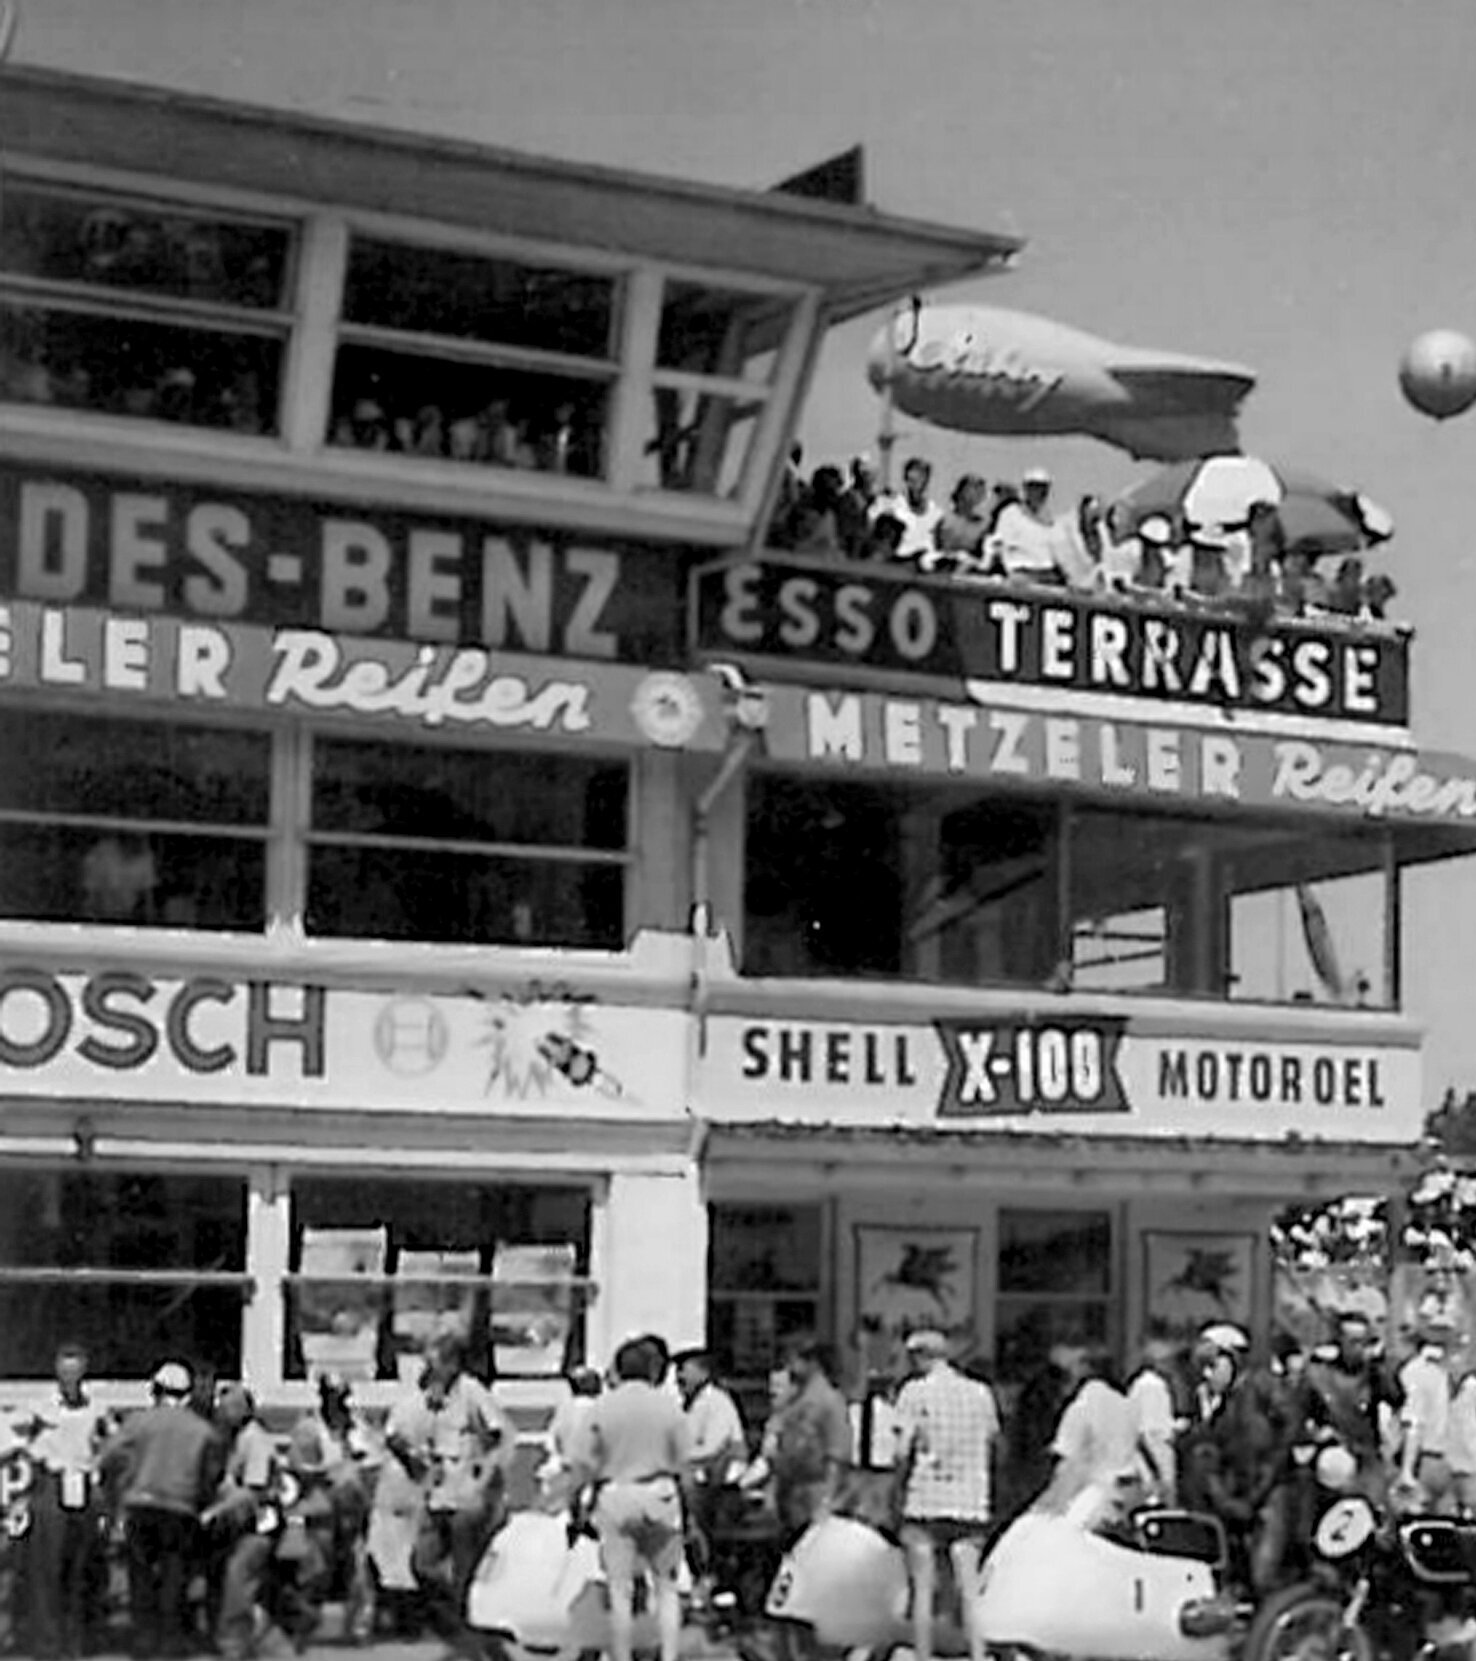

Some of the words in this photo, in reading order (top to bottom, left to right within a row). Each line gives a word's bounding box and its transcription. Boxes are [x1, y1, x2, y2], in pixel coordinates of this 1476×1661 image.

[0, 606, 233, 698] LER
[266, 629, 592, 731] Reifen
[723, 565, 938, 660] ESSO
[988, 601, 1379, 713] TERRASSE
[807, 692, 1239, 799] METZELER
[741, 1027, 916, 1086] SHELL
[957, 1029, 1101, 1103] X-100
[1158, 1049, 1386, 1108] MOTOROEL
